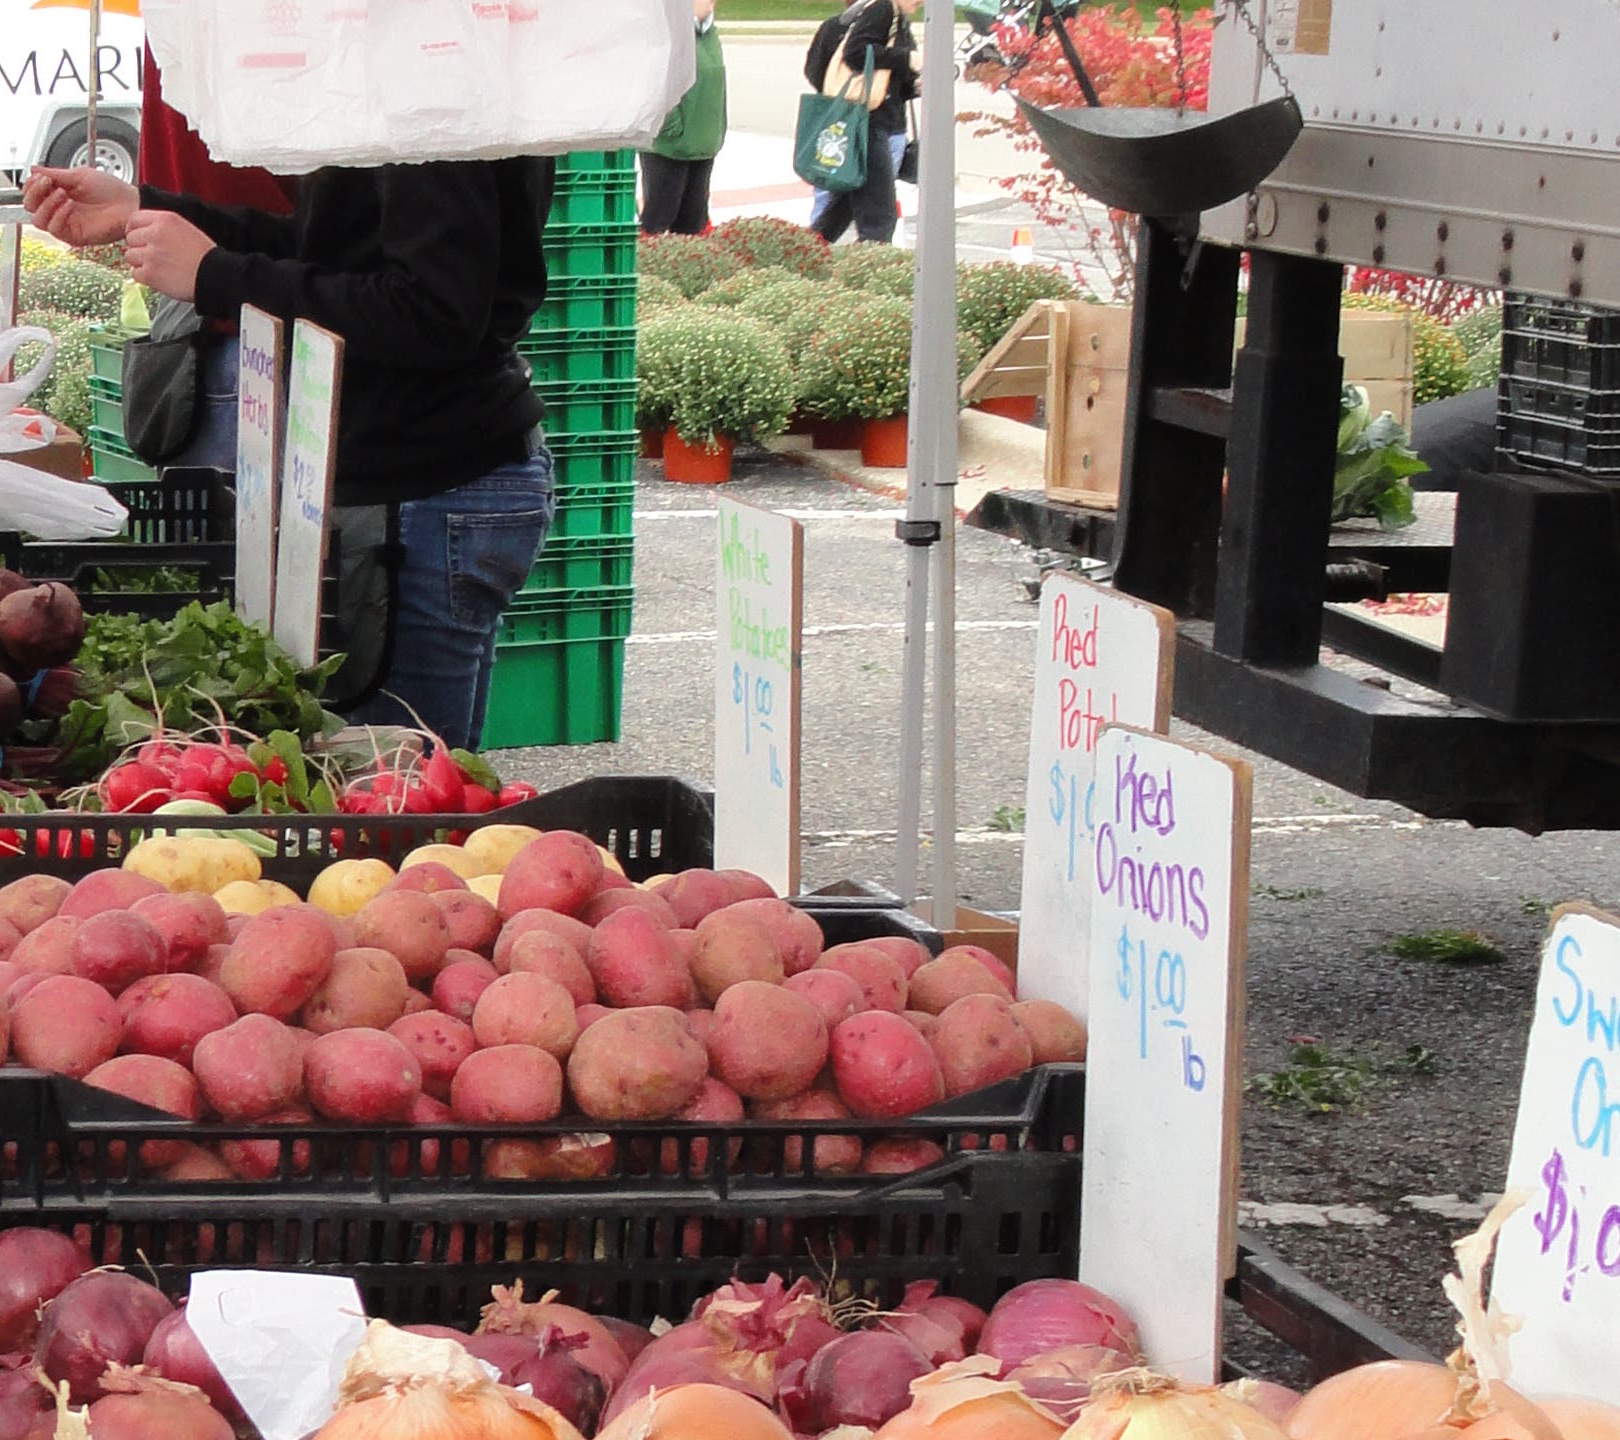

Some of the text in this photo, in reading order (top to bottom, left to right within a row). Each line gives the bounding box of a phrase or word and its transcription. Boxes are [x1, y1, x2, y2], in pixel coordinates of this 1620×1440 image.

[718, 505, 772, 586] White
[1053, 593, 1099, 669] Red
[1116, 753, 1176, 837] Red
[1096, 824, 1209, 941] Onions
[1553, 935, 1620, 1053] Sw
